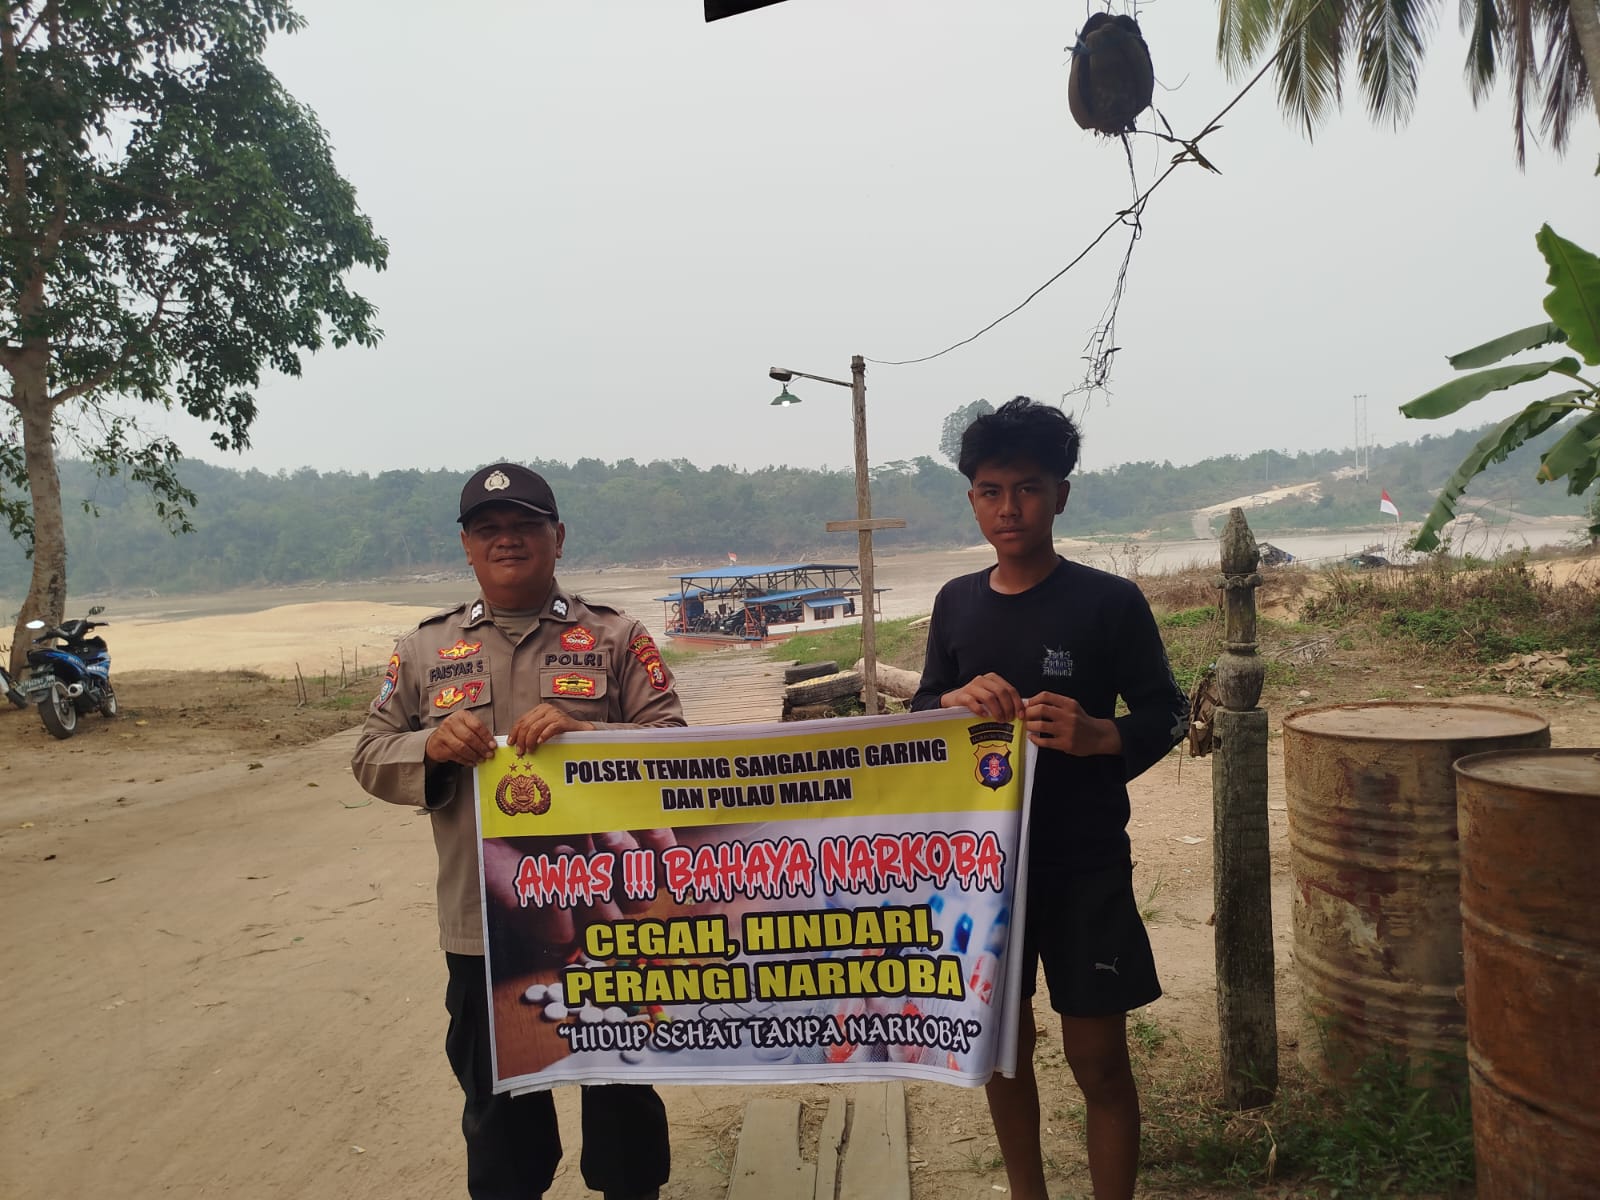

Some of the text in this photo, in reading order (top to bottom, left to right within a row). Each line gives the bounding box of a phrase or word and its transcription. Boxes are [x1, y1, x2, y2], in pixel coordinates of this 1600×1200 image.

[429, 660, 484, 682] FAISYAR S
[545, 653, 603, 667] POLRI
[565, 759, 642, 784] POLSEK
[643, 756, 731, 780] TEWANG
[735, 745, 861, 779] SANGALANG
[865, 738, 948, 767] GARING
[662, 777, 852, 811] DAN PULAU MALAN
[516, 832, 1005, 908] AWAS !!! BAHAYA NARKOBA
[584, 907, 940, 957] CEGAH, HINDARI,
[565, 957, 963, 1005] PERANGI NARKOBA
[558, 1014, 979, 1052] “HIDUP SEHAT TANPA NARKOBA”
